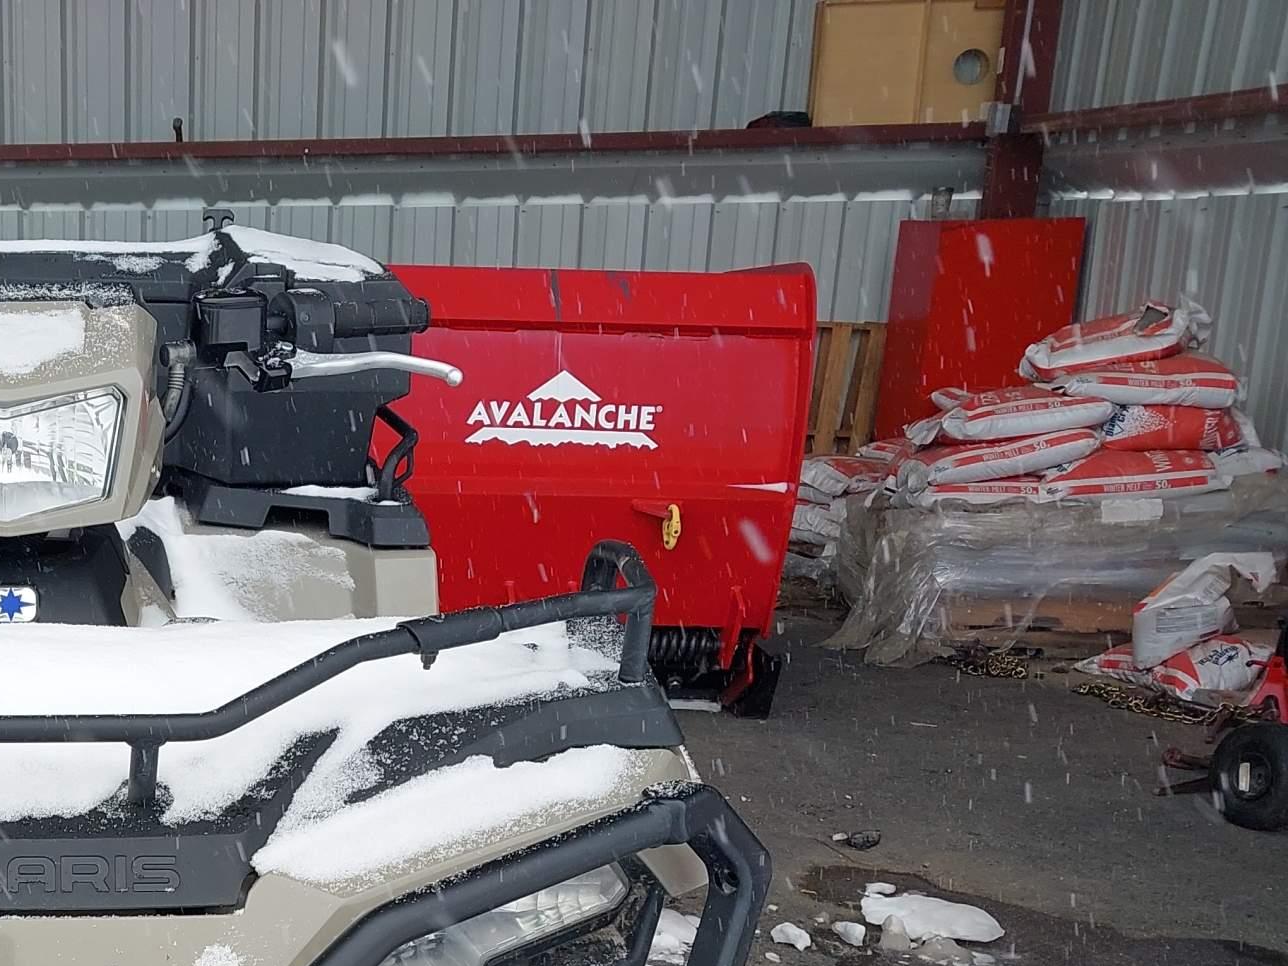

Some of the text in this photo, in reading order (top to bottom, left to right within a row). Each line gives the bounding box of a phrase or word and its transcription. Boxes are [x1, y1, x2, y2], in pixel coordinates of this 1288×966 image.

[466, 400, 657, 430] AVALANCHE
[1032, 440, 1047, 452] 50
[1020, 486, 1034, 495] 50
[1155, 480, 1168, 490] 50
